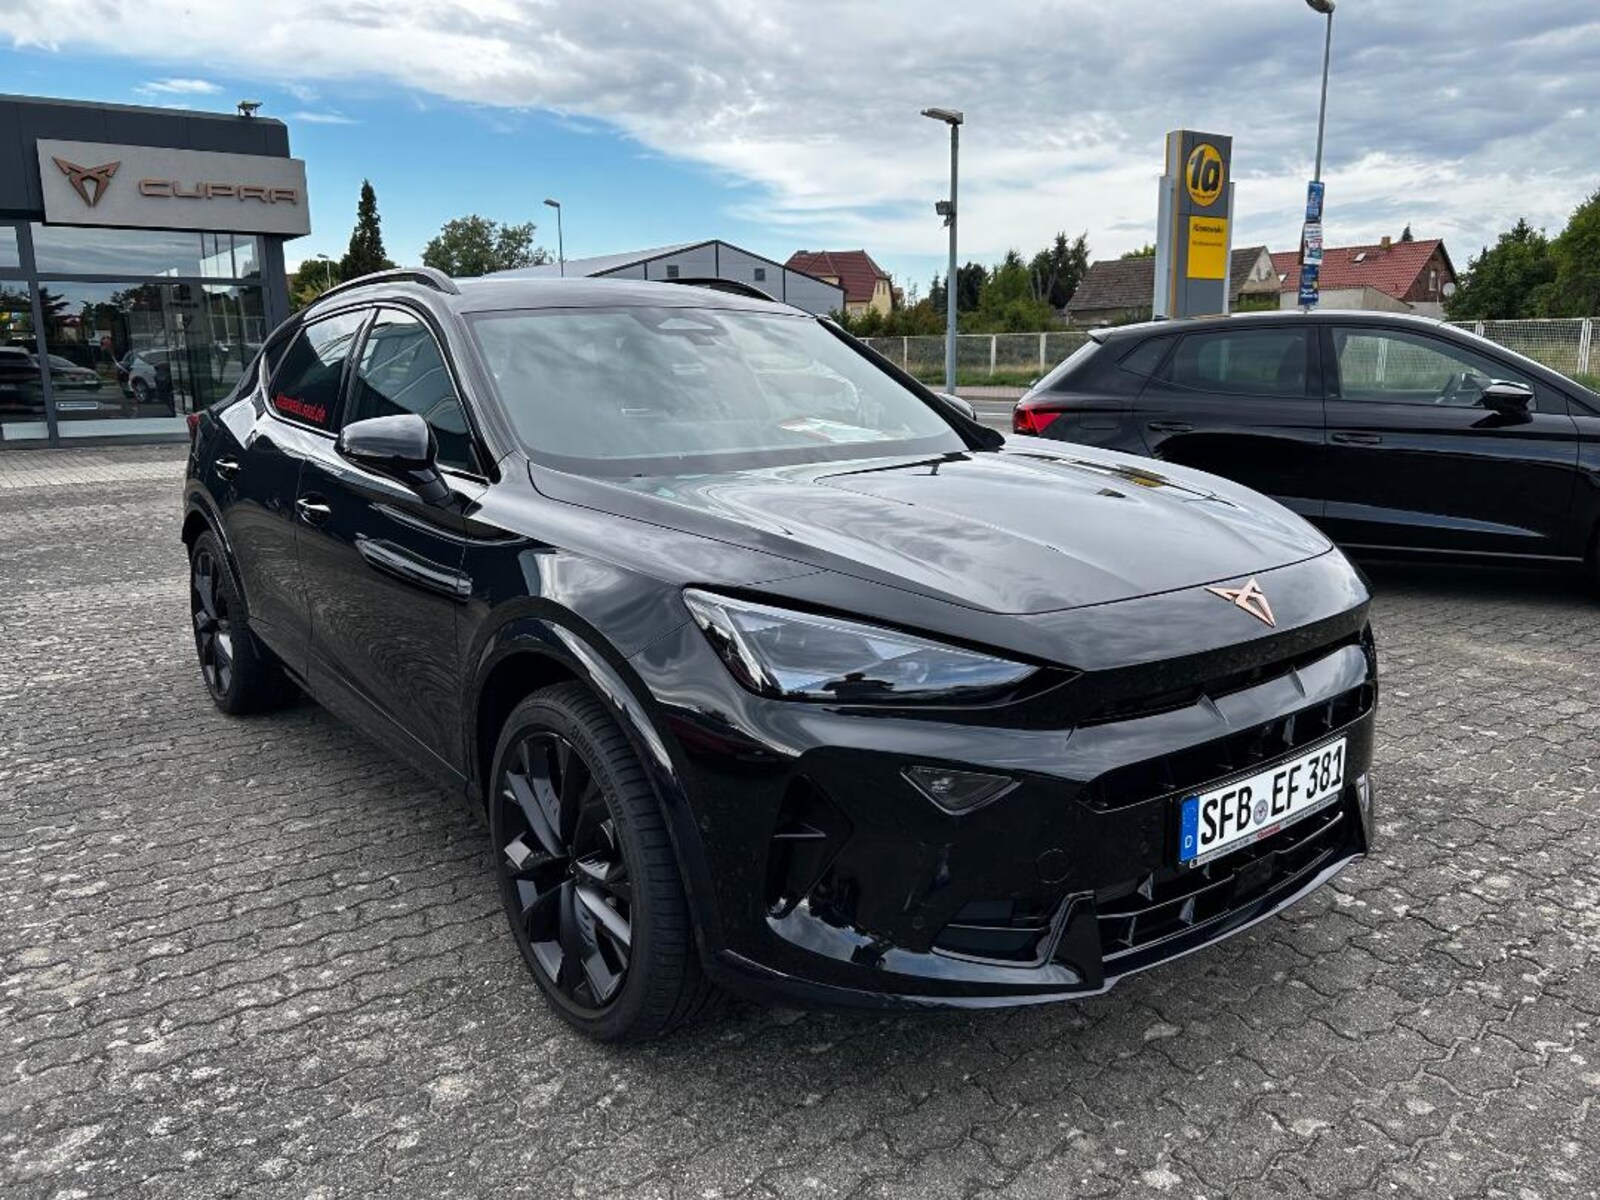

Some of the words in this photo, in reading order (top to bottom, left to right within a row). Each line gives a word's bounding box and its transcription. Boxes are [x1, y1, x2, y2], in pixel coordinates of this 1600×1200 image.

[1190, 149, 1220, 192] 1a
[139, 178, 298, 205] CUPRA
[1201, 786, 1252, 845] SFB
[1271, 764, 1302, 817] EF
[1306, 745, 1343, 799] 381
[1185, 834, 1194, 849] D
